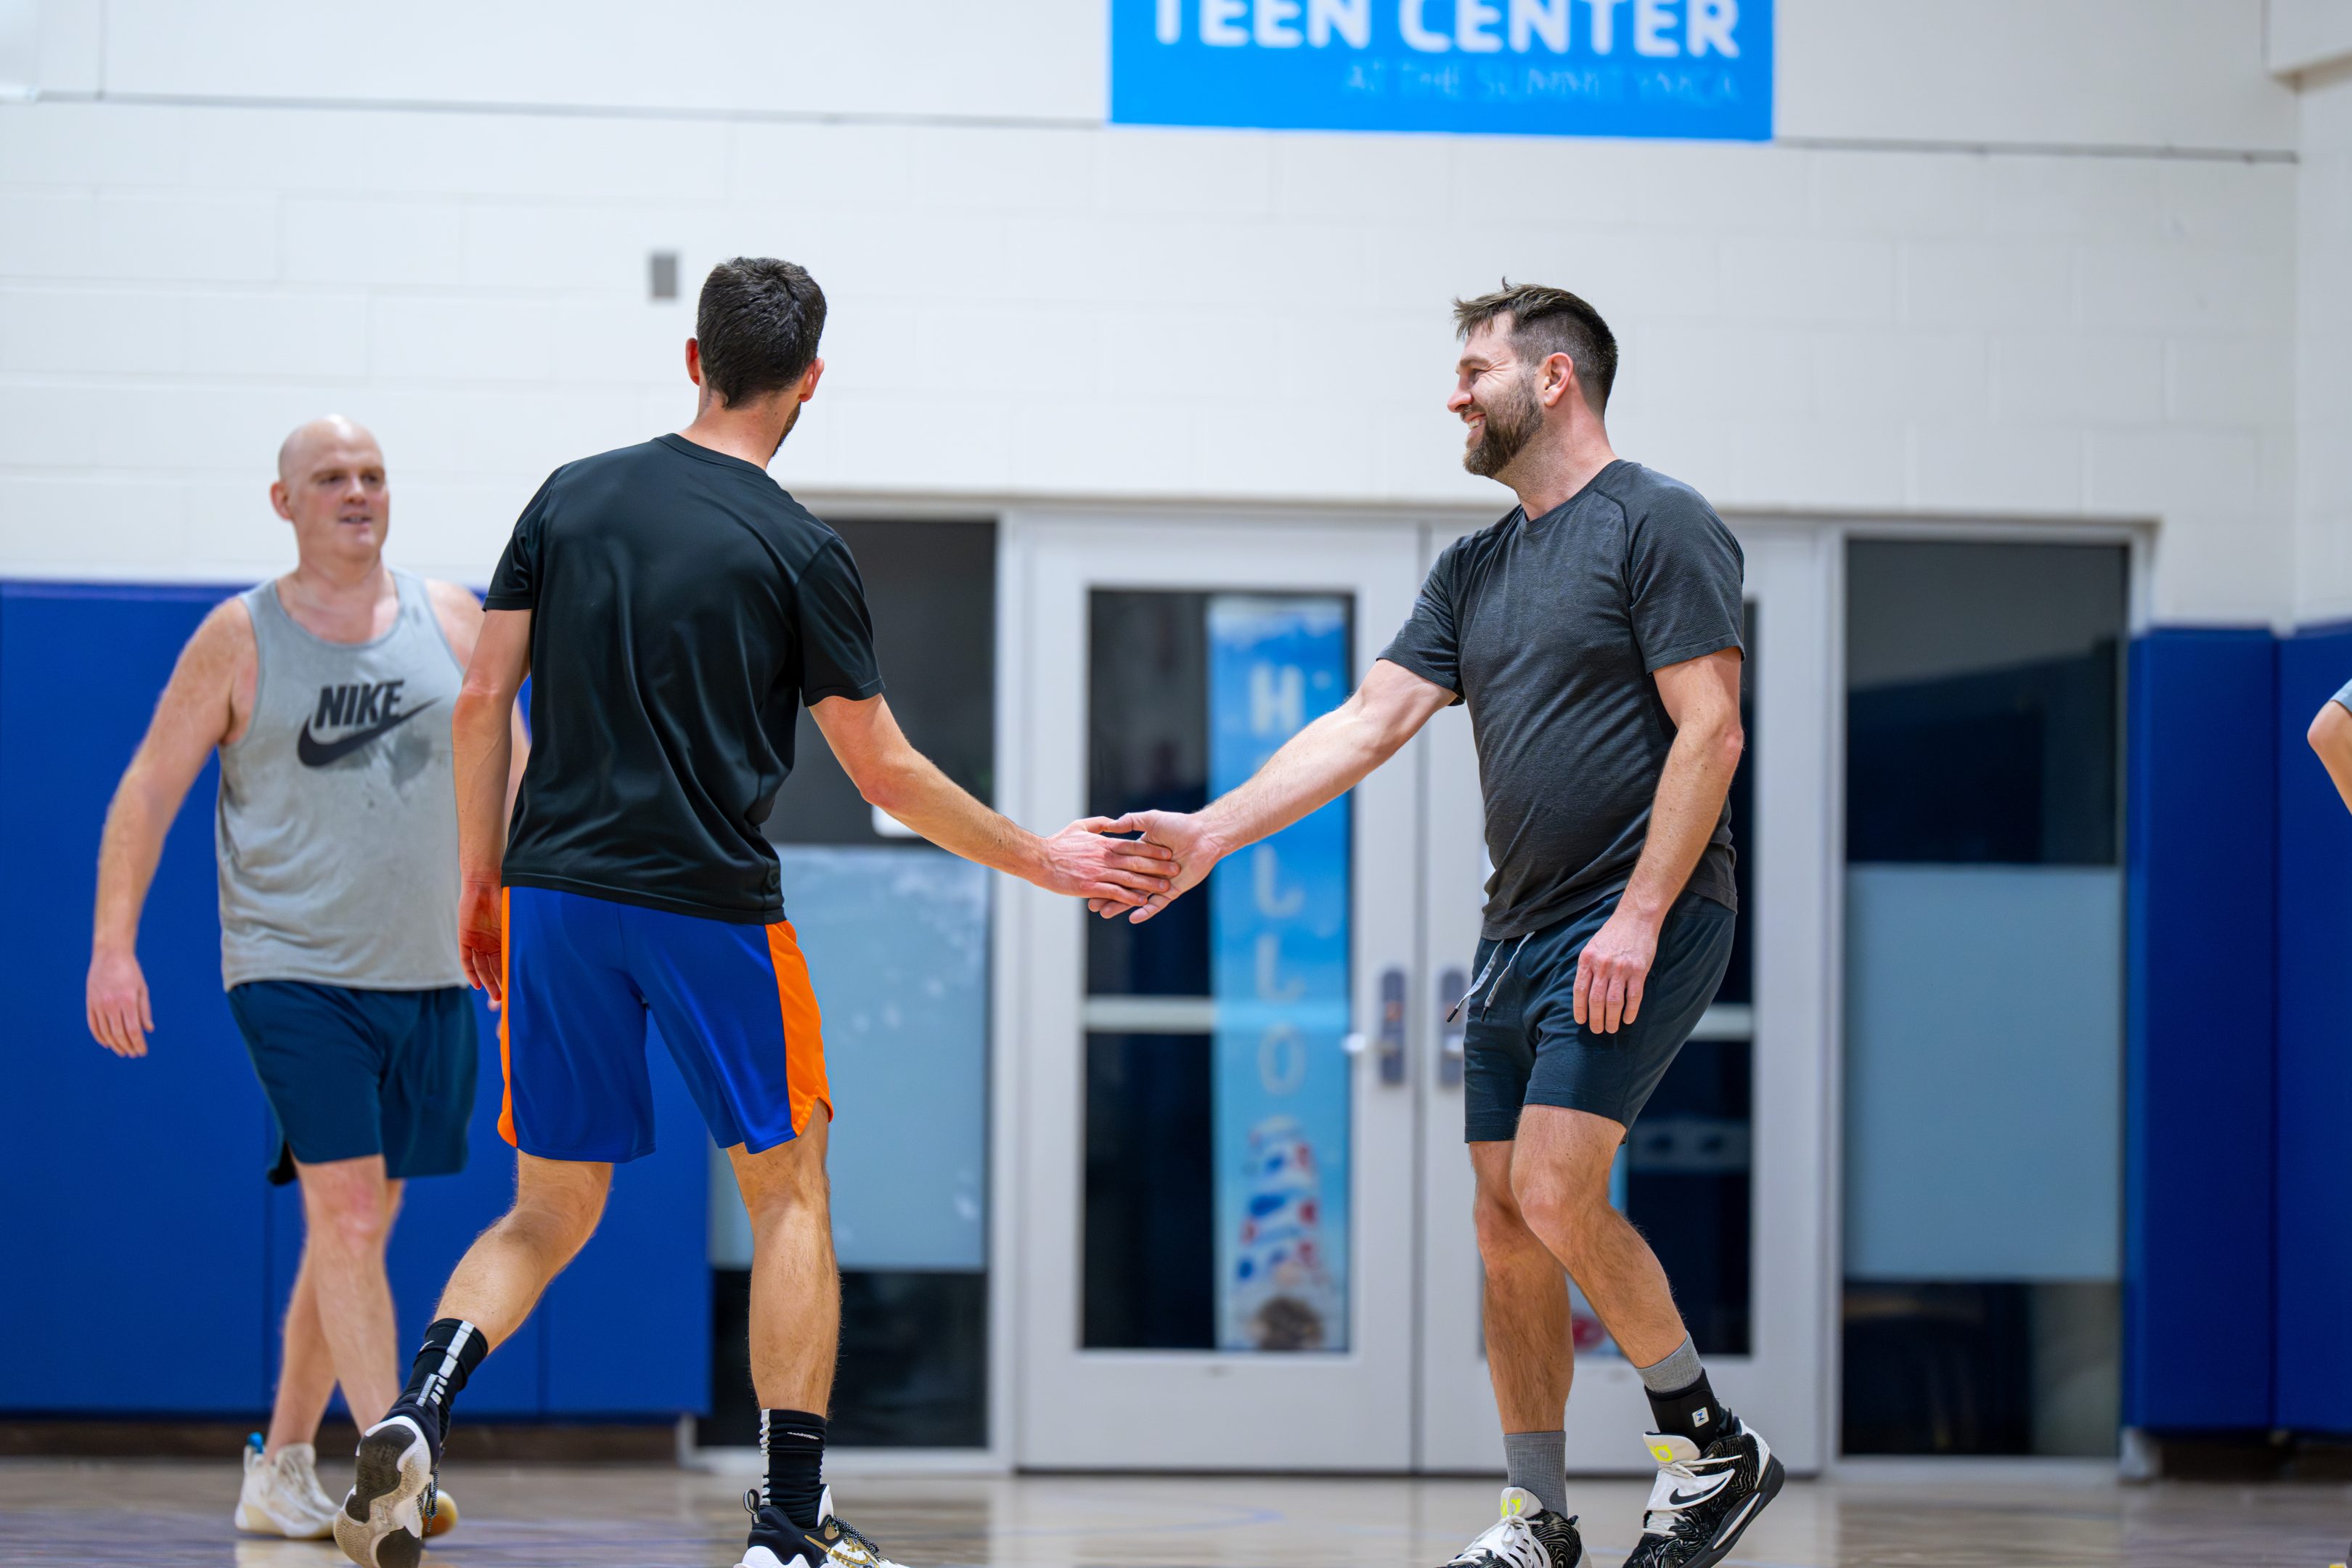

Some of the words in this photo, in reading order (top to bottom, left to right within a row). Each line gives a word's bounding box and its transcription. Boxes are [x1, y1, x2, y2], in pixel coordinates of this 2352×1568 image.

[1399, 0, 1740, 57] CENTER
[314, 679, 404, 729] NIKE
[1251, 663, 1306, 1095] HLLO
